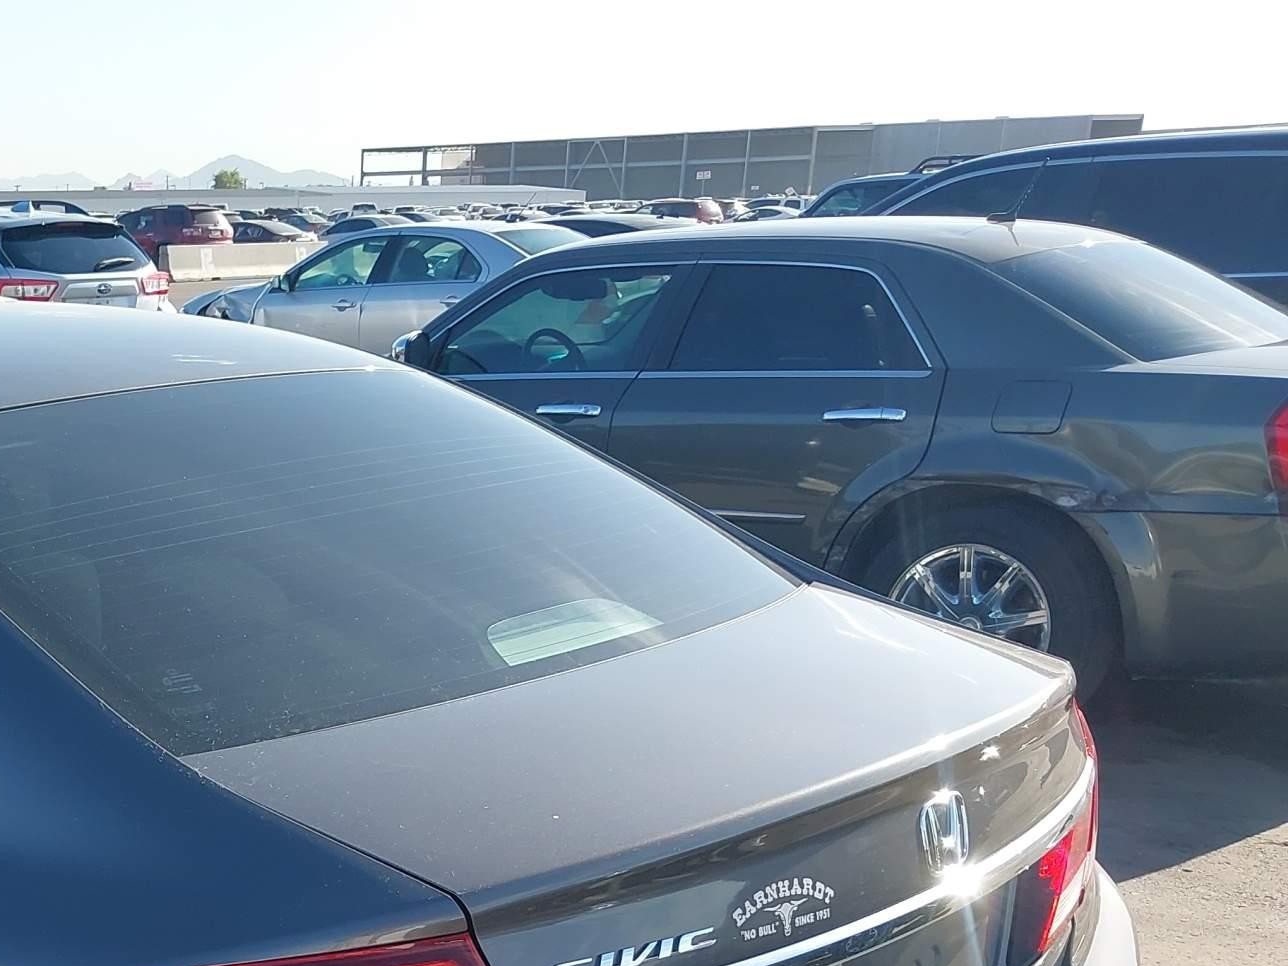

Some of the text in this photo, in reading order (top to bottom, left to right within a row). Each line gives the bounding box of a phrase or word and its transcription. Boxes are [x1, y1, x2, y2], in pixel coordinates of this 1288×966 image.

[732, 877, 835, 928] EARNHARDT
[794, 907, 831, 928] SINCE 1951
